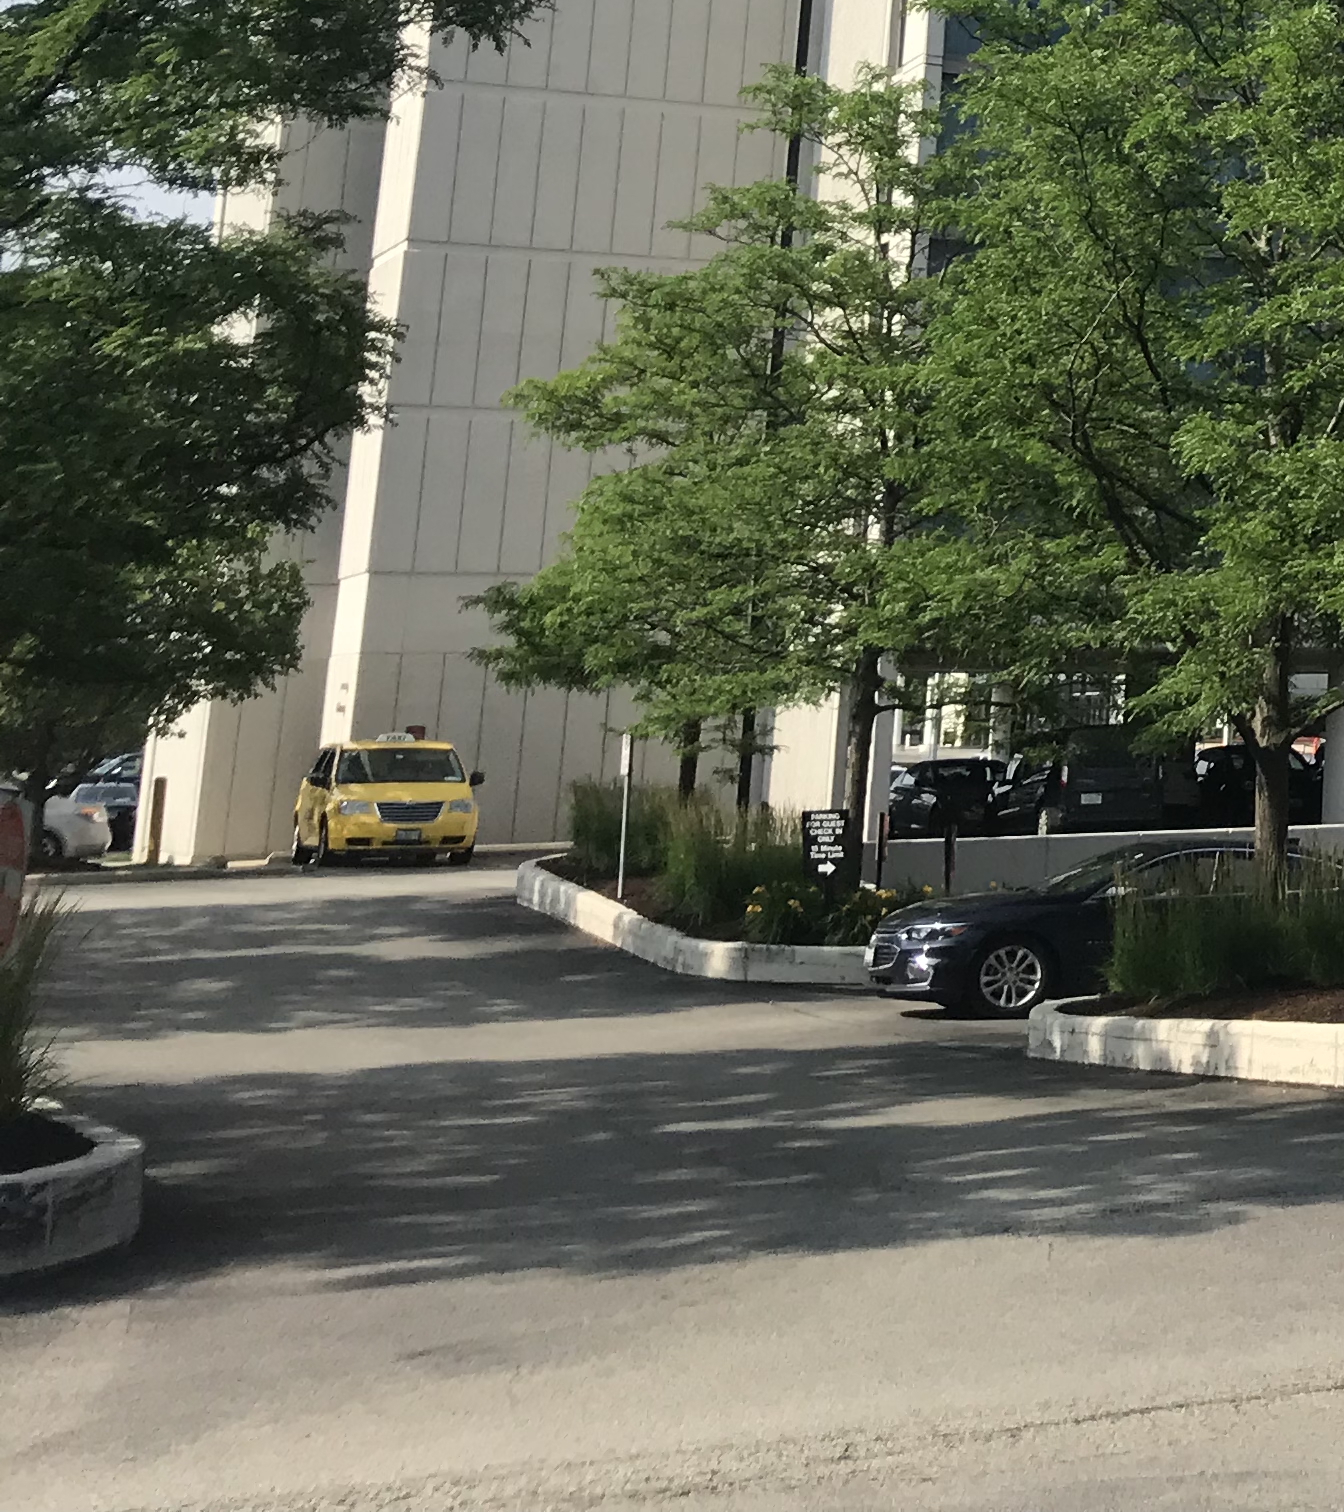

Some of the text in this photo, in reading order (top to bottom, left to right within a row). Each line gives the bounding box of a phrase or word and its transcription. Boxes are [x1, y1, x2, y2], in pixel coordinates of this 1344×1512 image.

[810, 812, 840, 820] PARKING
[806, 819, 845, 828] FOR GUEST
[809, 827, 834, 835] CHECK
